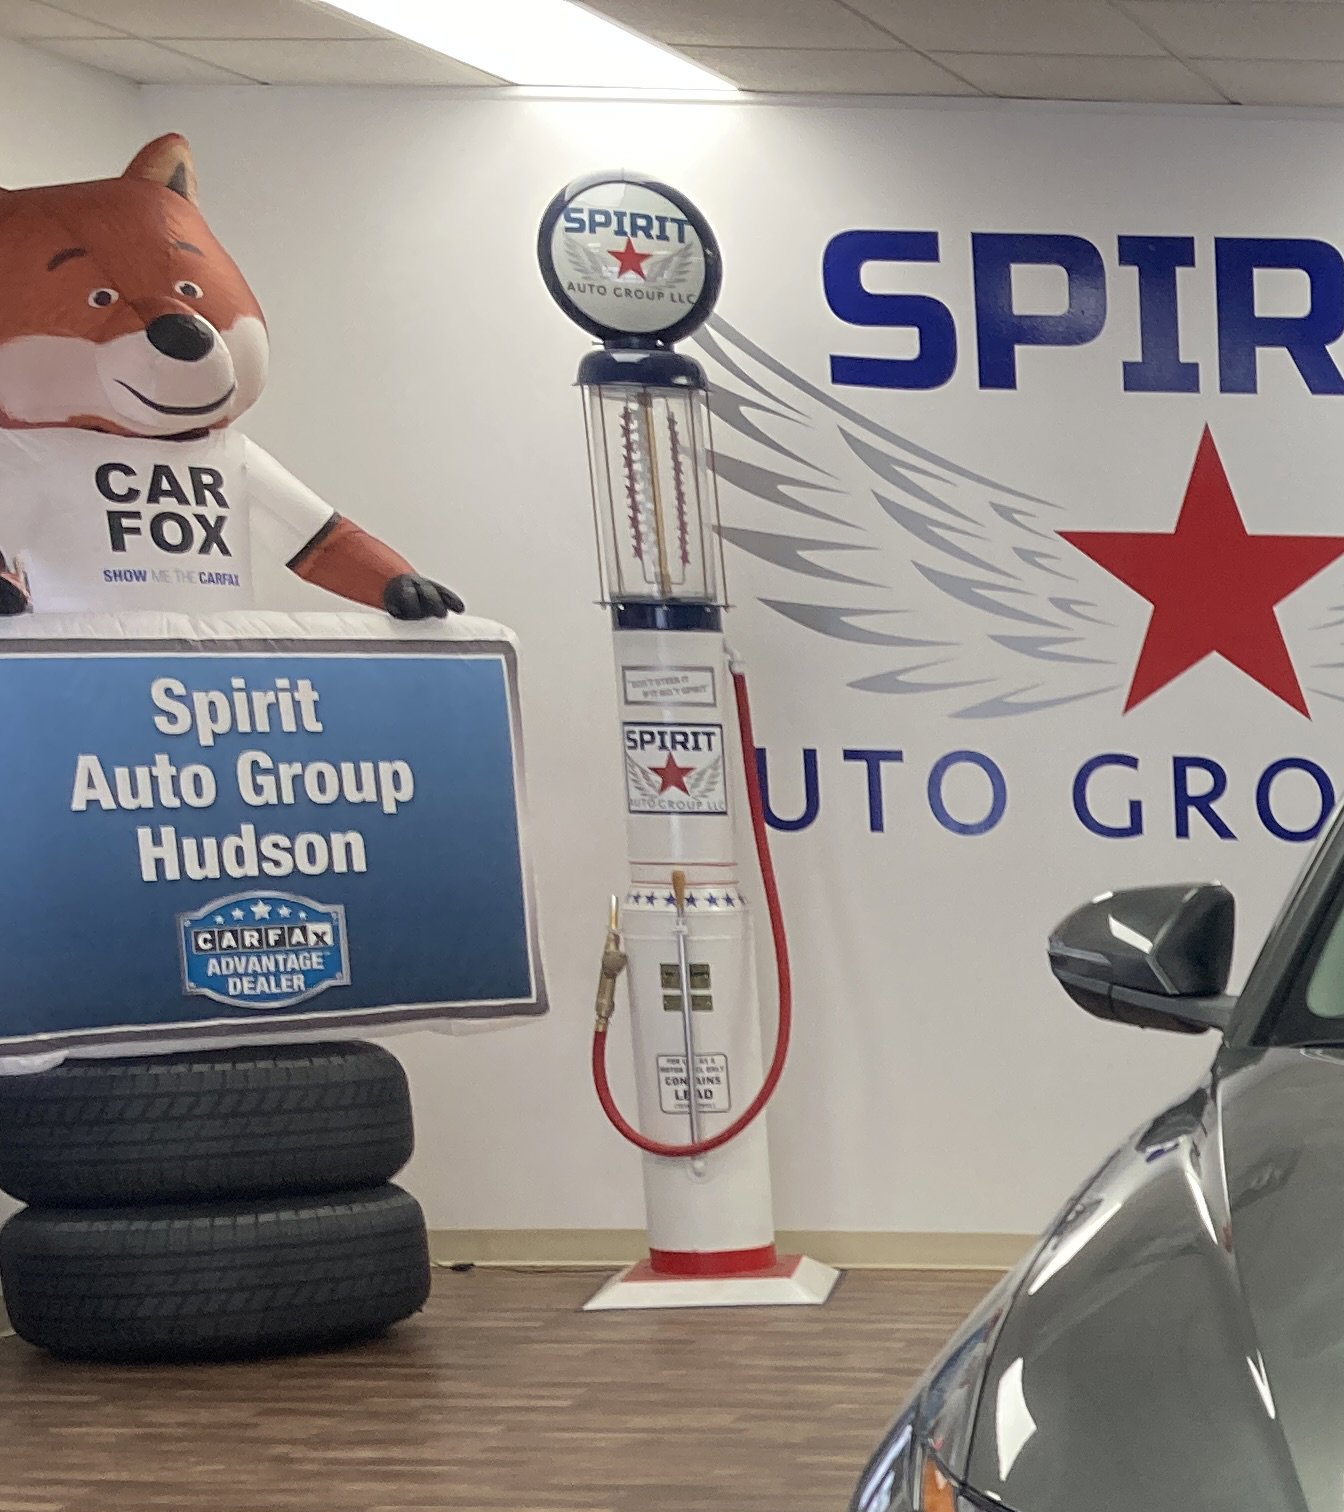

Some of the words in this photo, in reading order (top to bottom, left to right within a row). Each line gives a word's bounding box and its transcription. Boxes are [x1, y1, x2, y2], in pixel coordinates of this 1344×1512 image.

[564, 208, 691, 243] SPIRIT
[567, 281, 607, 296] AUTO
[613, 287, 664, 301] GROUP
[670, 293, 697, 304] LLC
[95, 462, 230, 509] CAR
[106, 510, 232, 557] FOX
[103, 569, 147, 583] SHOW
[152, 569, 170, 584] ME
[175, 570, 197, 584] THE
[199, 571, 241, 587] CARFAX
[151, 677, 323, 746] Spirit
[626, 730, 716, 751] SPIRIT
[71, 754, 216, 811] Auto
[236, 750, 414, 814] Group
[657, 799, 703, 811] GROUP
[755, 748, 1007, 836] UTO
[1072, 753, 1335, 843] GRO
[136, 823, 367, 882] Hudson
[195, 925, 331, 951] CARFAX
[207, 952, 325, 976] ADVANTAGE
[227, 974, 306, 995] DEALER
[665, 1076, 721, 1086] CONAINS
